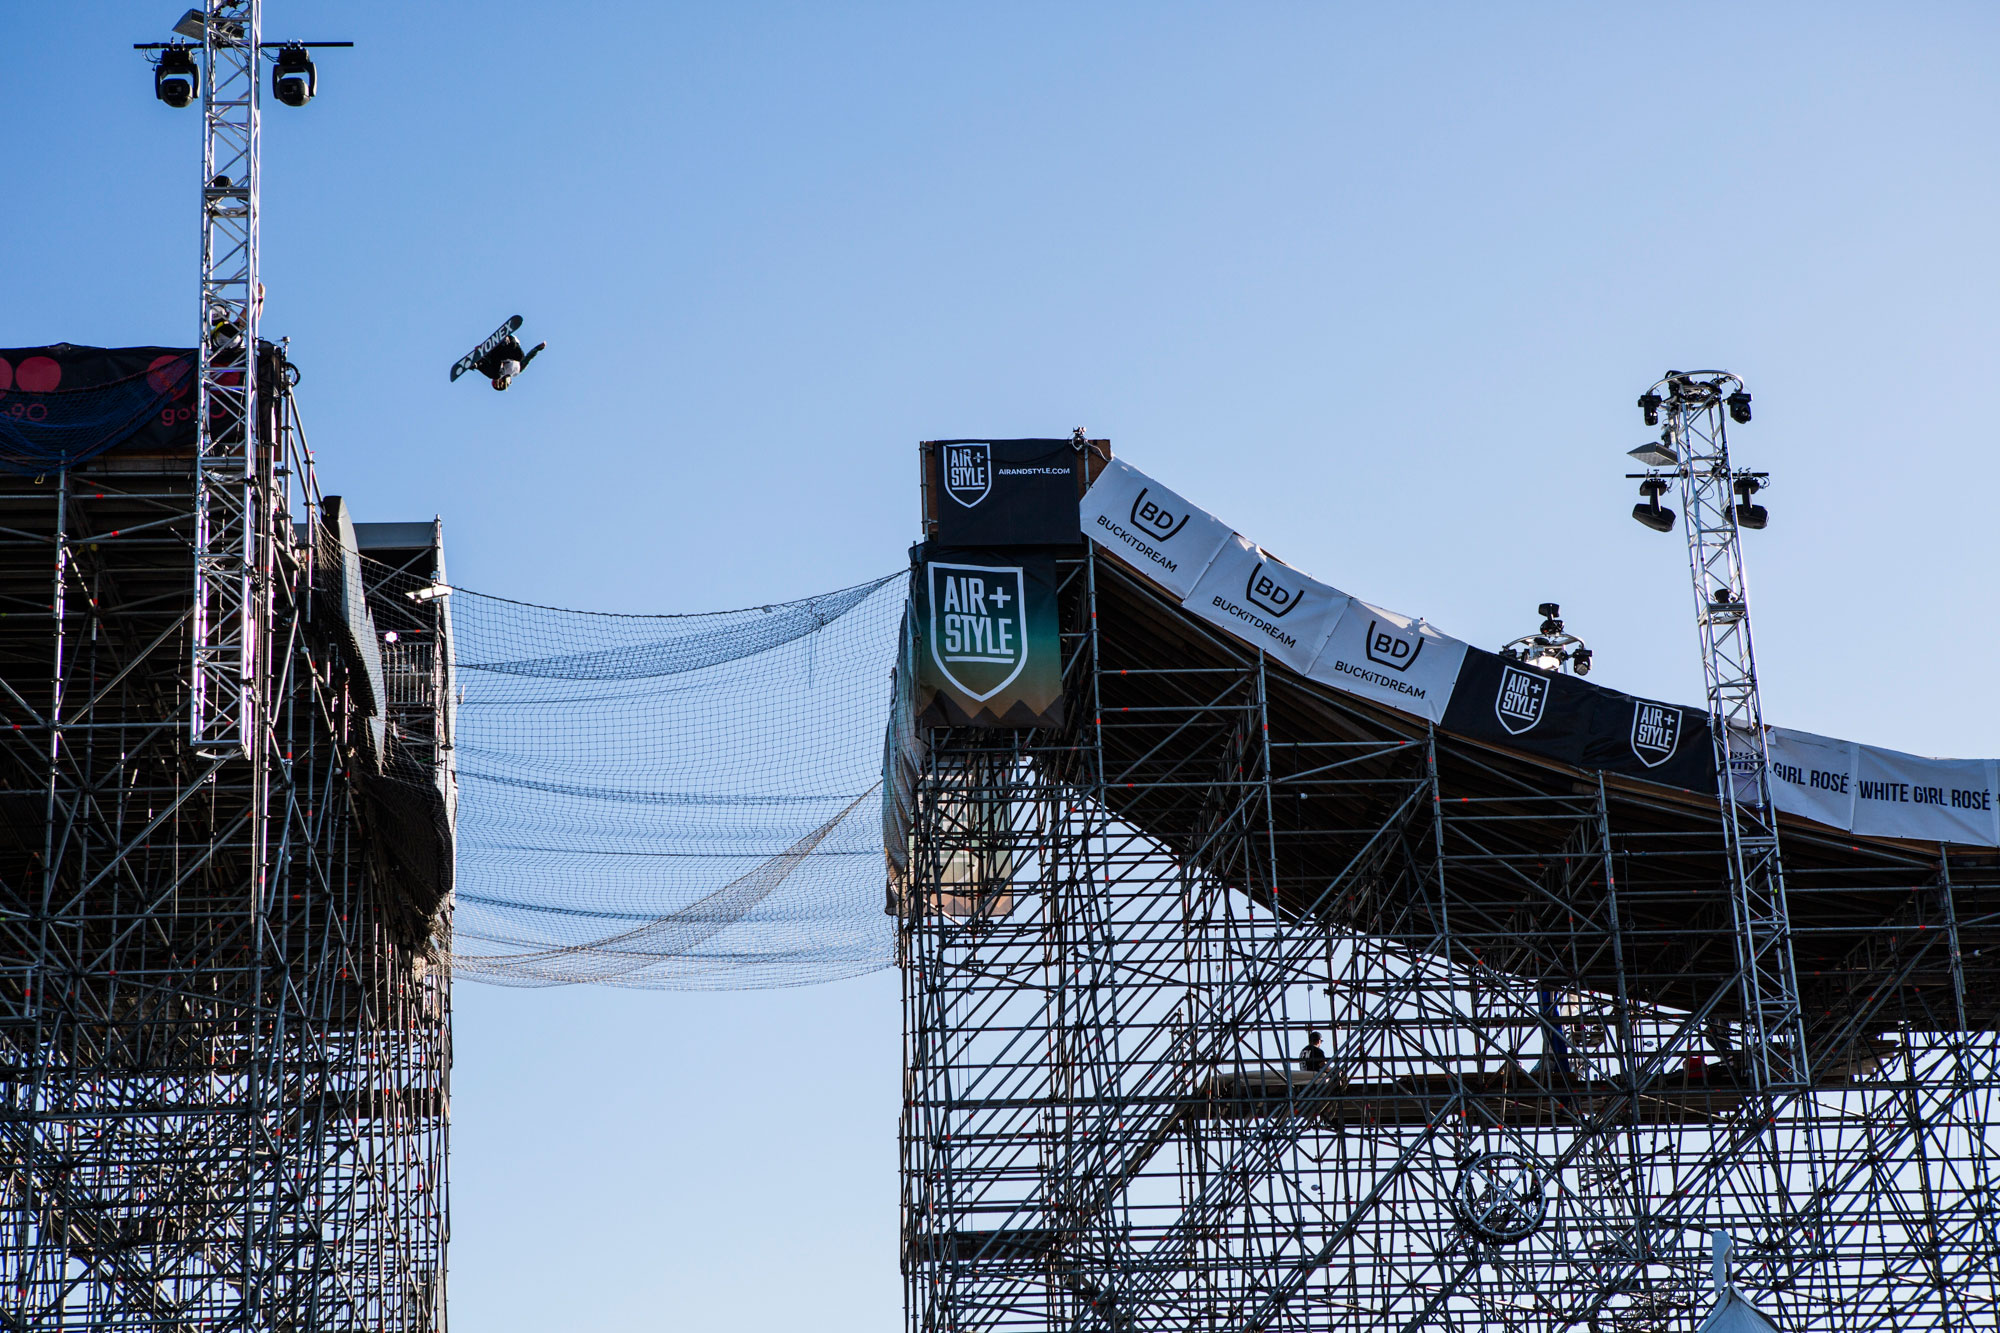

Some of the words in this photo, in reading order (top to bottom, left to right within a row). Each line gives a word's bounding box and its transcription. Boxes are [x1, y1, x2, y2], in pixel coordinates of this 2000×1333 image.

[478, 320, 513, 357] YONEX
[0, 402, 48, 422] 90
[952, 467, 985, 486] STYLE
[998, 467, 1070, 475] AIRANDSTYLE.COM
[1138, 501, 1174, 530] BD
[1254, 575, 1290, 605] BD
[945, 614, 1014, 655] STYLE
[1374, 633, 1410, 658] BD
[1502, 691, 1539, 717] STYLE
[1637, 724, 1673, 749] STYLE
[1773, 761, 1806, 786] GIRL
[1810, 769, 1849, 795] ROSÉ
[1859, 780, 1909, 802] WHITE
[1913, 785, 1948, 807] GIRL
[1951, 788, 1991, 811] ROSÉ
